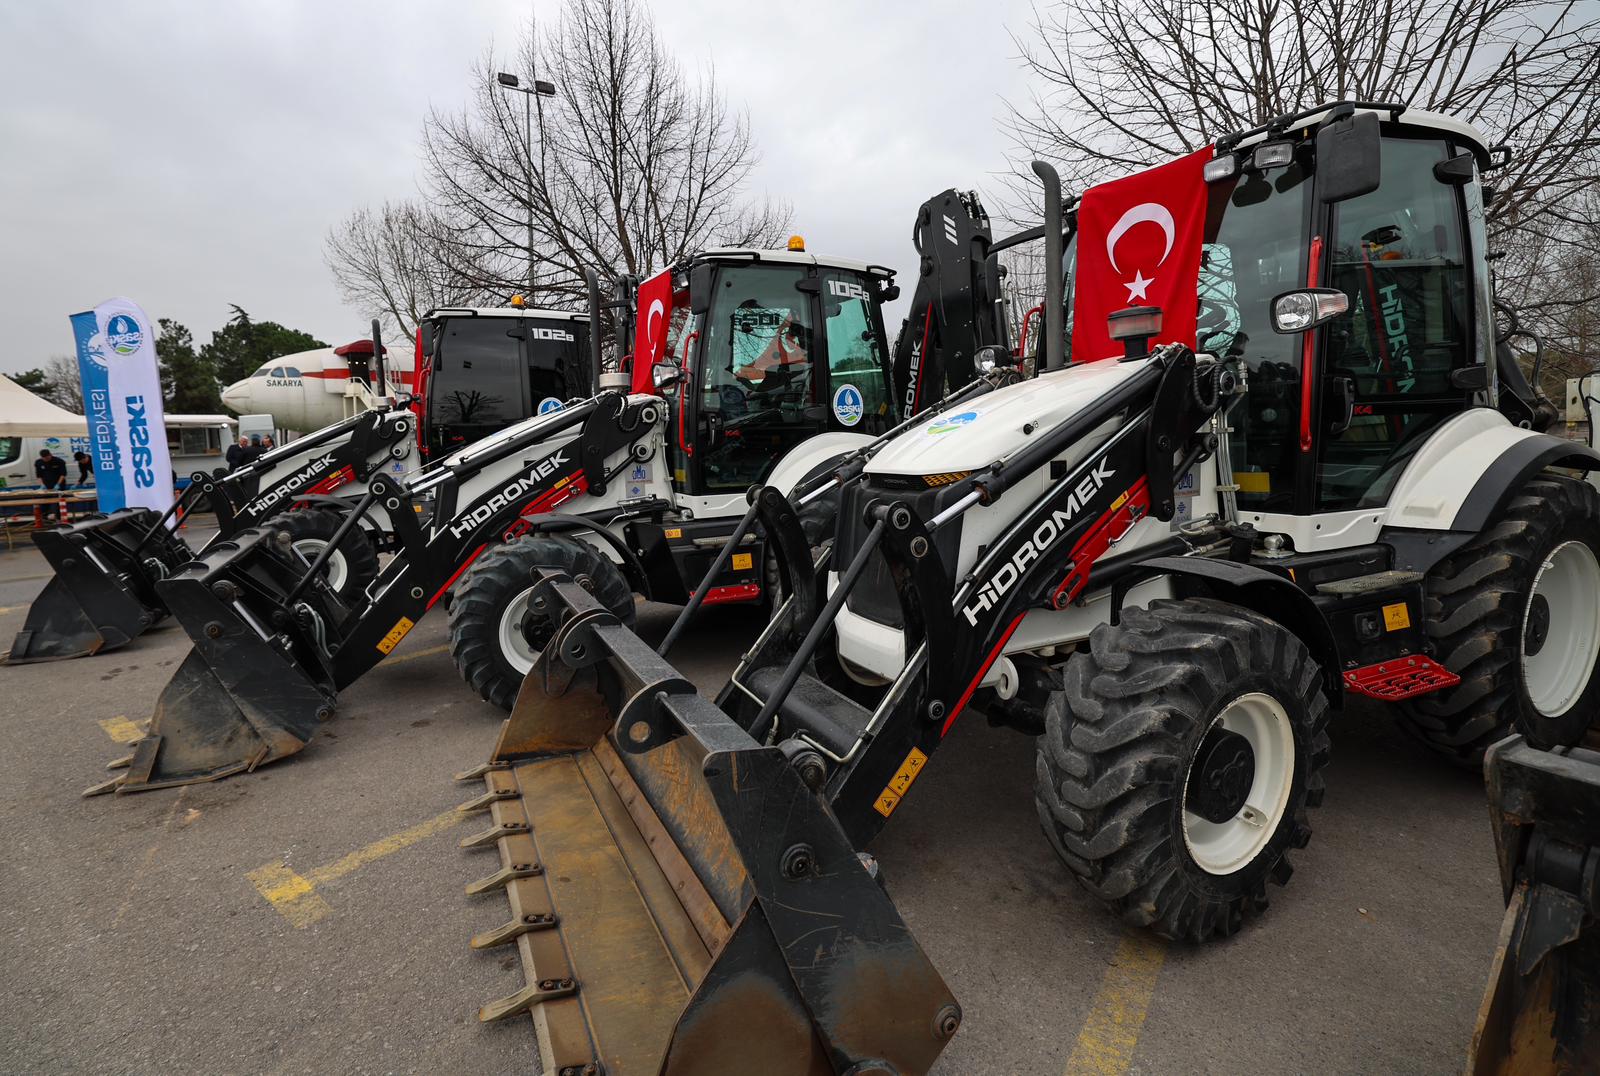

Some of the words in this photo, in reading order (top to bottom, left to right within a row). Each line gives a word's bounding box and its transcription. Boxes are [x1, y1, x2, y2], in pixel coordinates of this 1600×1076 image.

[828, 280, 870, 302] 102B
[532, 328, 575, 342] 102B
[903, 340, 922, 421] ROMEK
